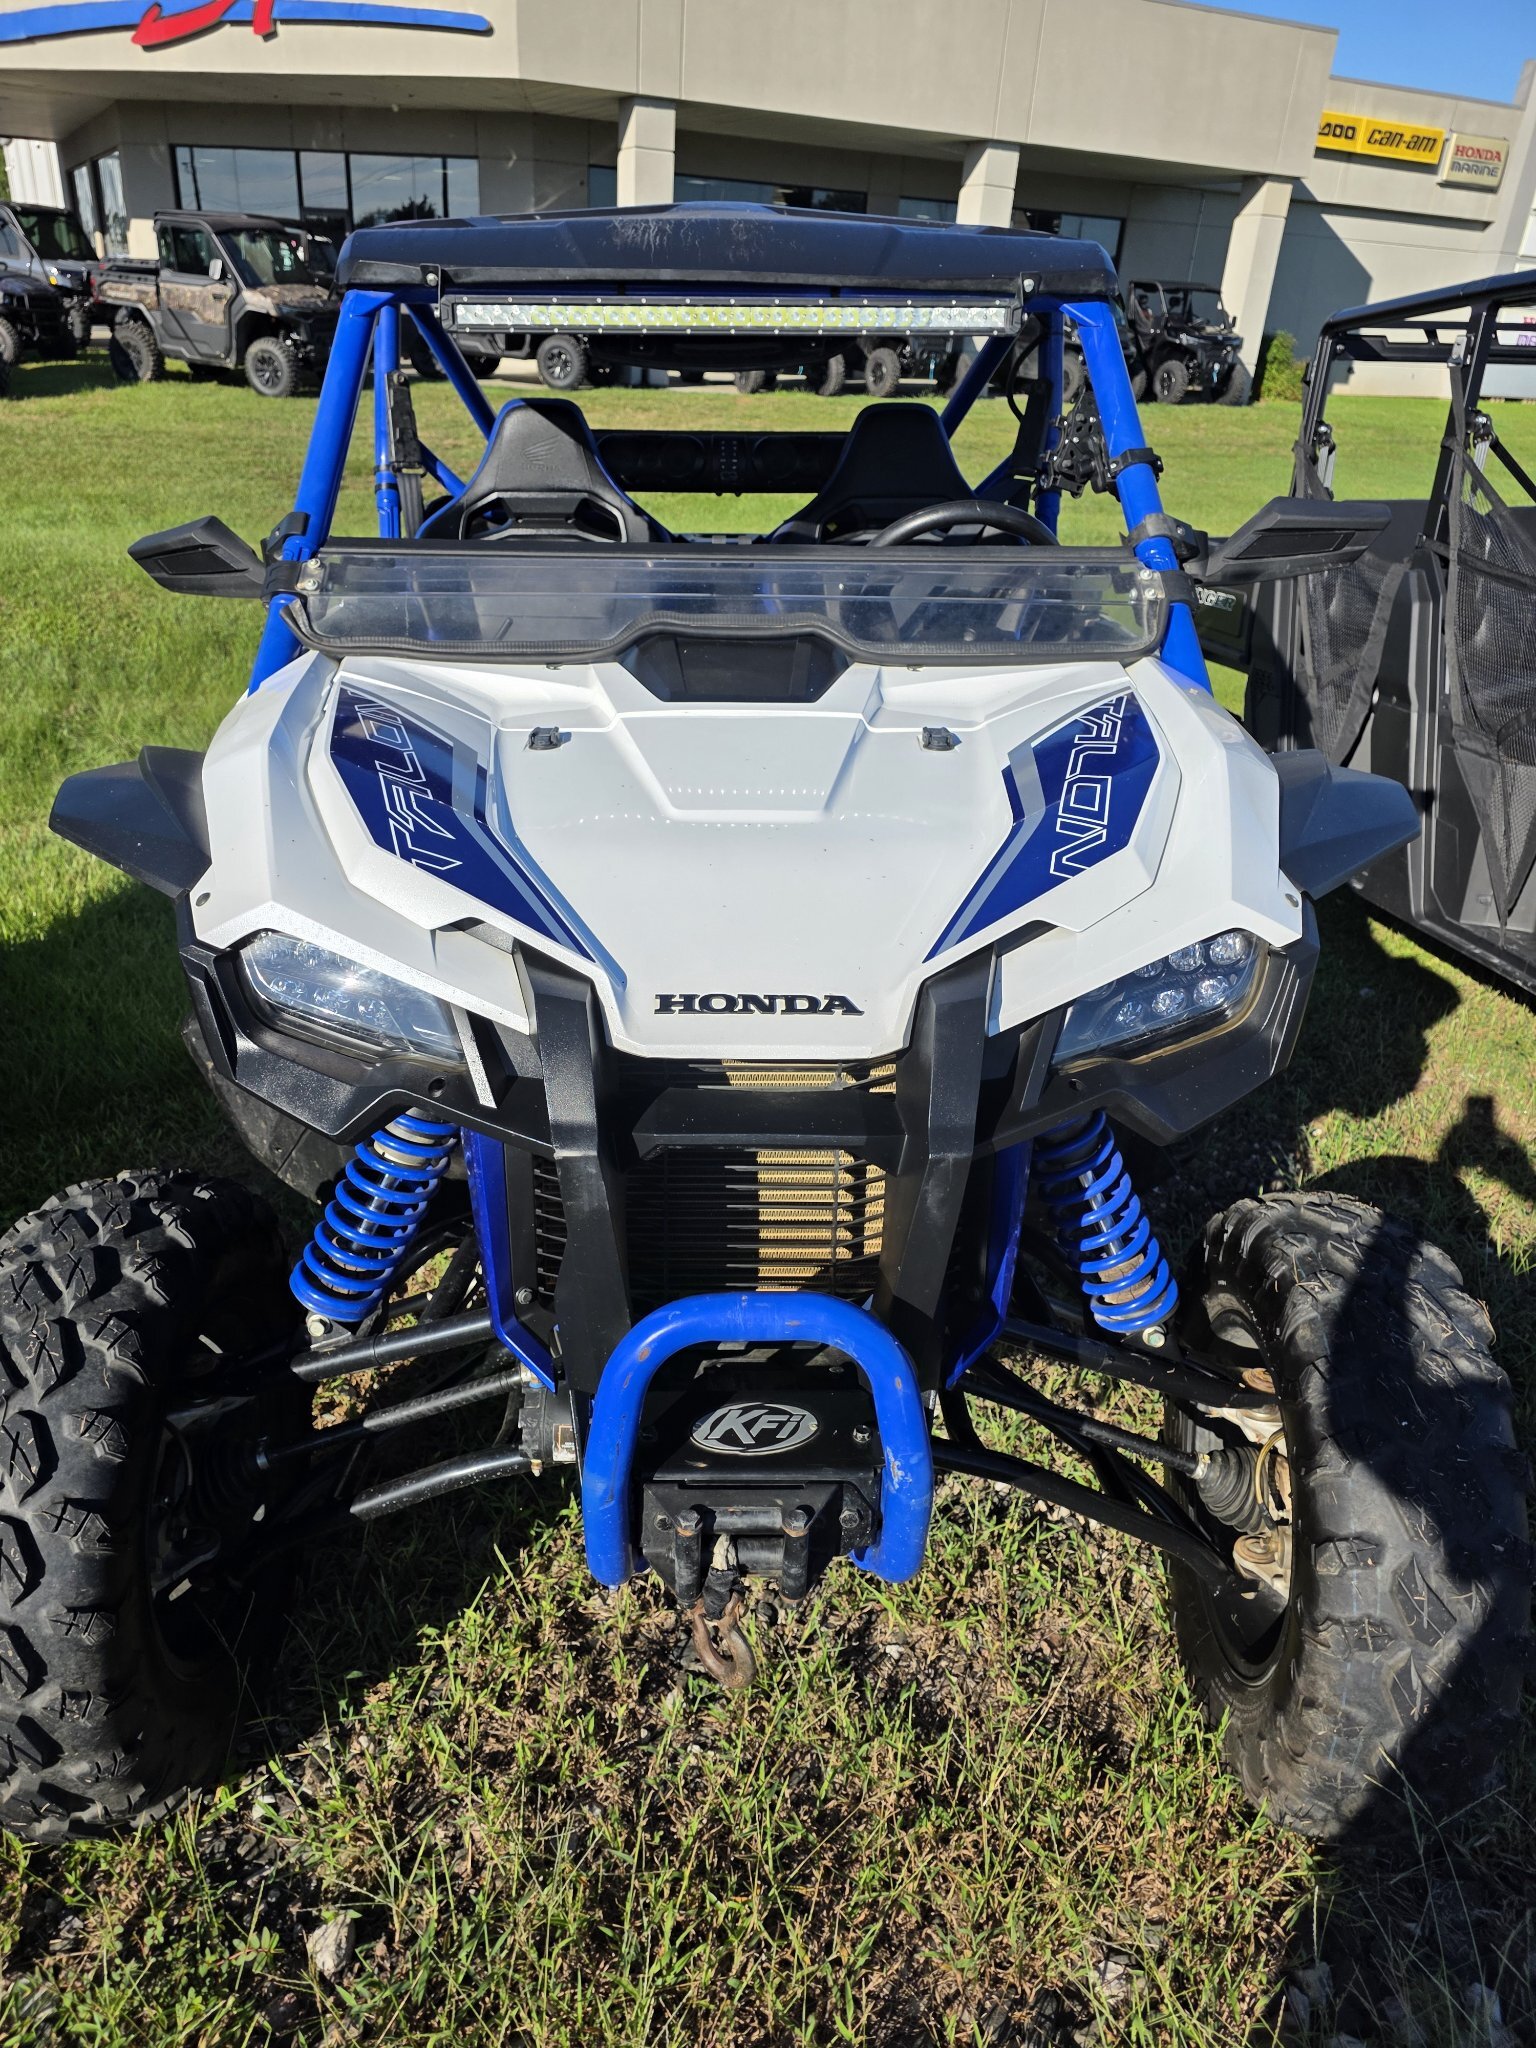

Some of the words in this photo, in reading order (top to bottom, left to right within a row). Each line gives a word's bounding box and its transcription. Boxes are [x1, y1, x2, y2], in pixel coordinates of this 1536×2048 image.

[1367, 128, 1438, 154] can-am
[1455, 144, 1502, 163] HONDA
[1450, 161, 1499, 178] MARINE
[346, 690, 463, 870] TALON
[1050, 695, 1127, 878] TALON
[654, 993, 865, 1016] HONDA
